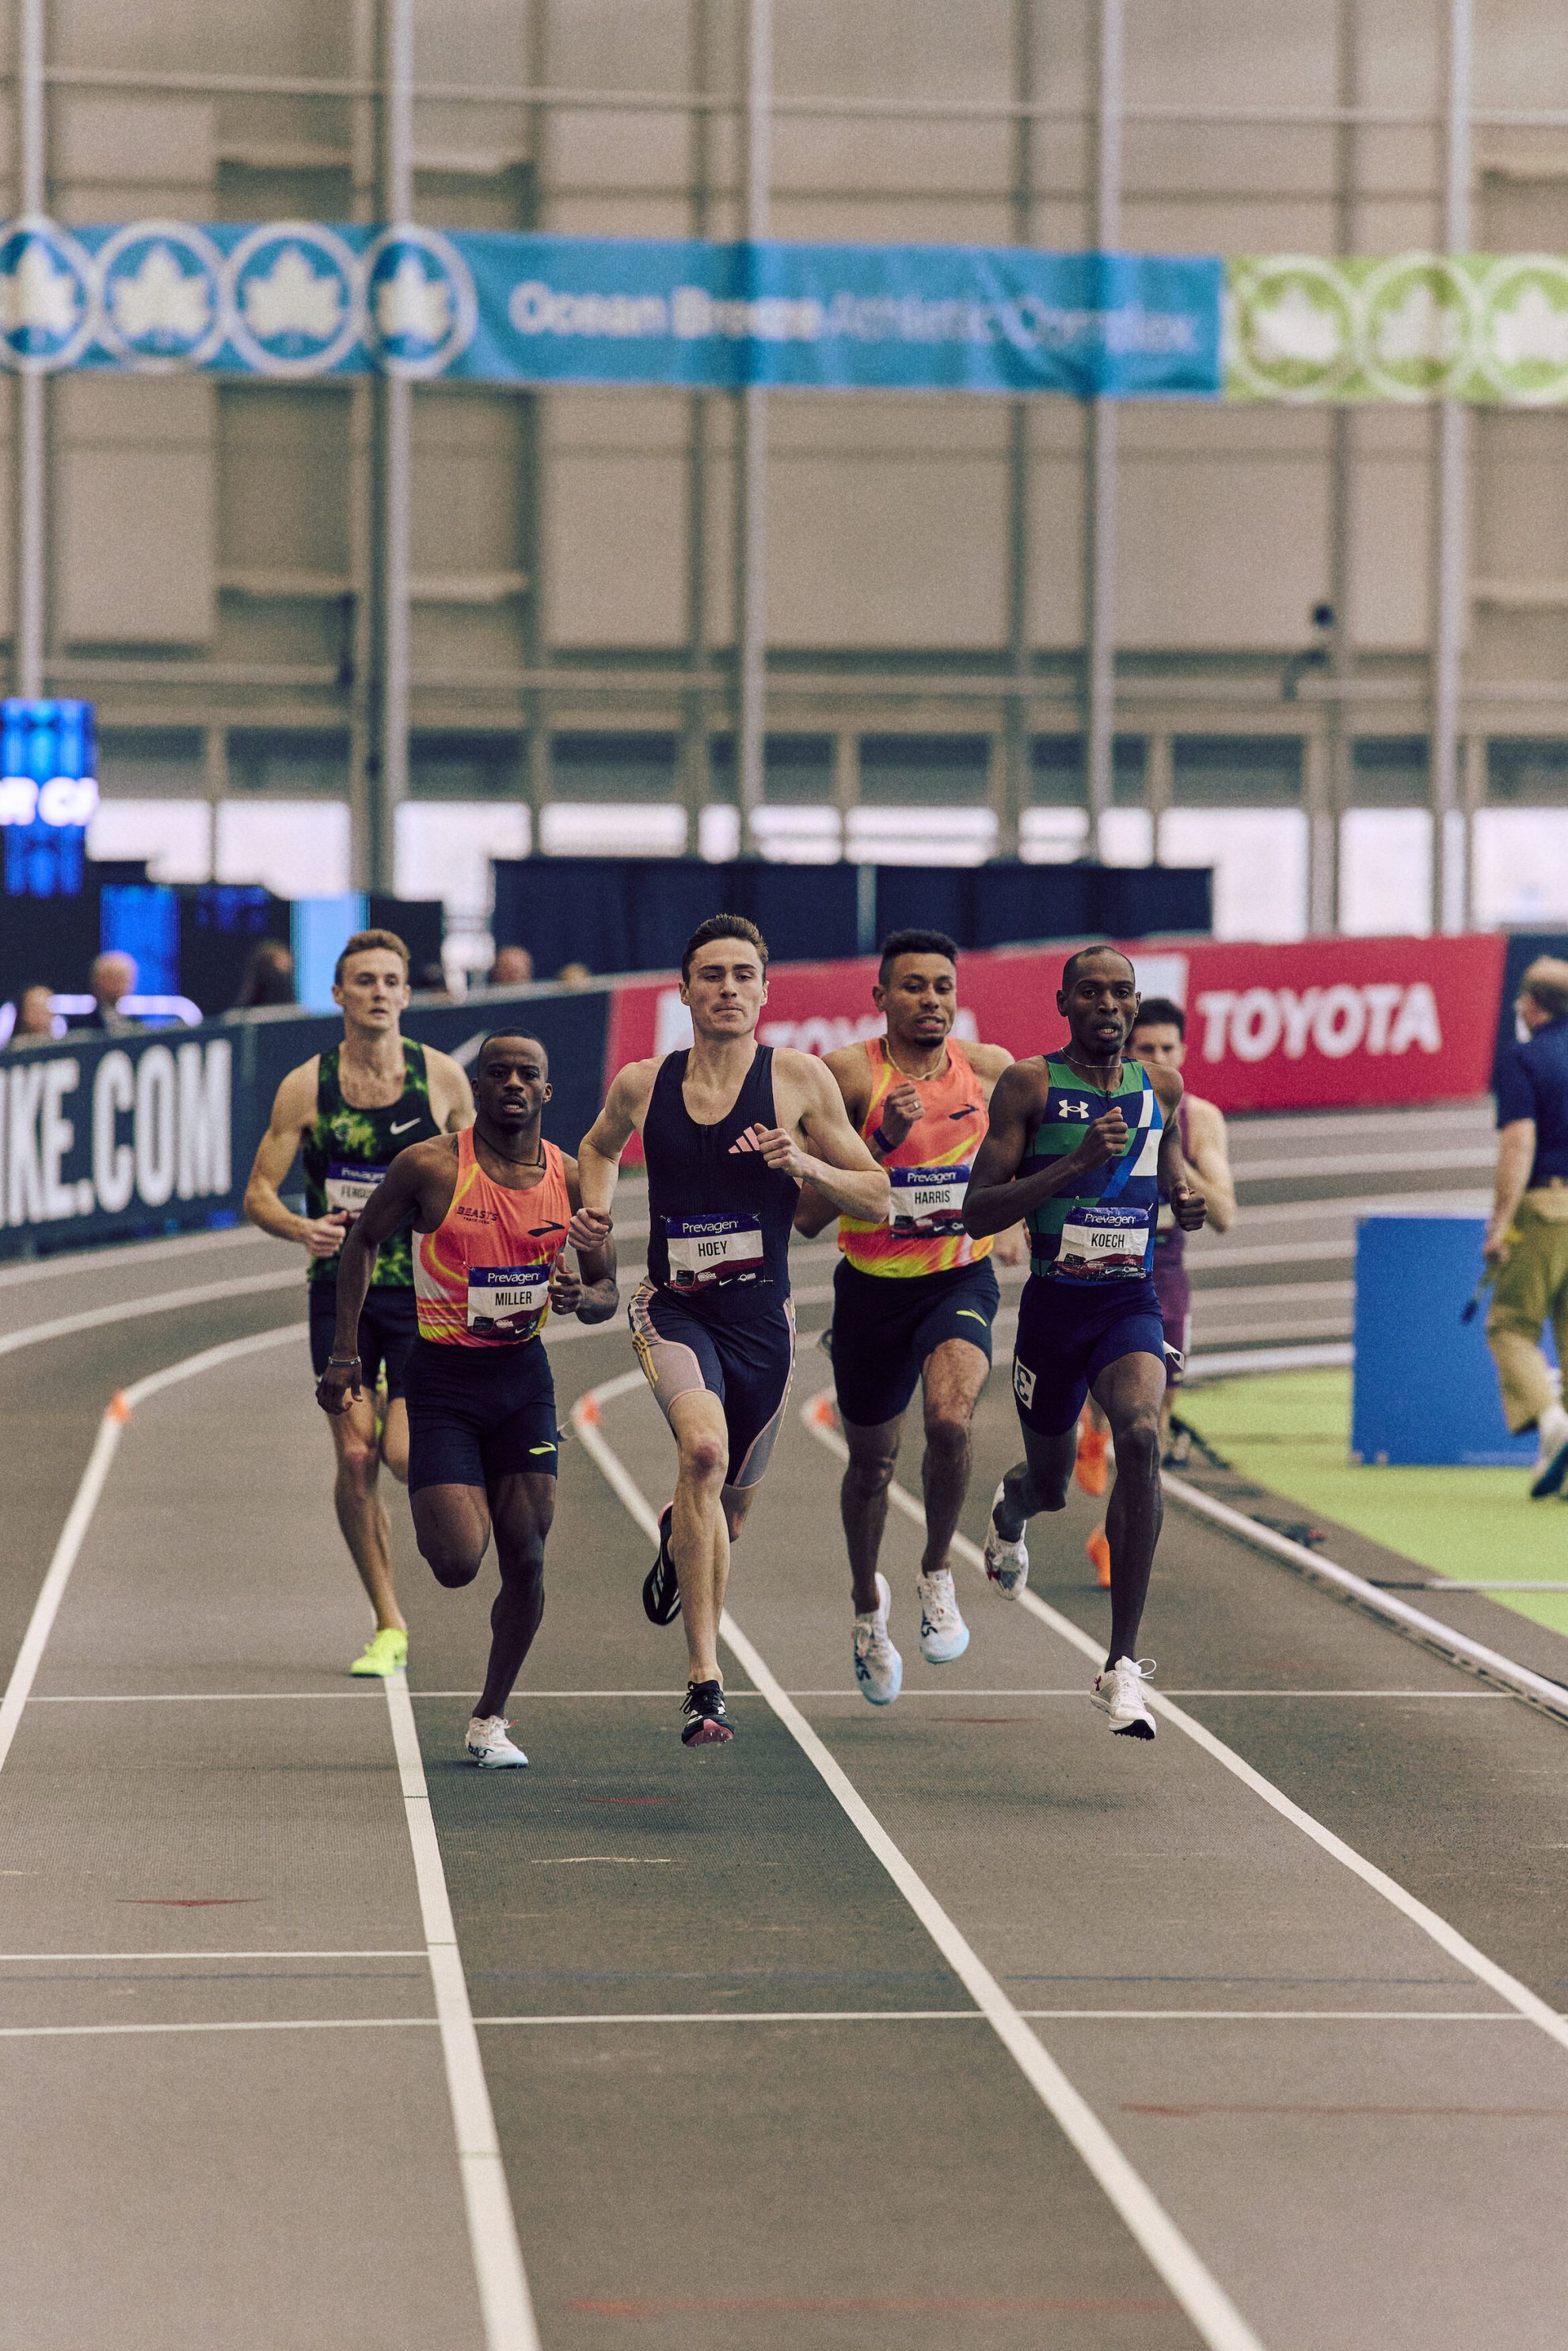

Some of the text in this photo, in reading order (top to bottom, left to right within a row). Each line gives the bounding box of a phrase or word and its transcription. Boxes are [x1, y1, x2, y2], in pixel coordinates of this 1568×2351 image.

[1197, 982, 1443, 1064] TOYOTA
[907, 1172, 957, 1183] Prevagen
[915, 1190, 950, 1204] HARRIS
[457, 1206, 499, 1221] BEASTS
[1084, 1214, 1136, 1226] Prevagen
[683, 1221, 738, 1233] Prevagen
[1091, 1233, 1125, 1248] KOECH
[698, 1240, 728, 1257] HOEY
[488, 1273, 539, 1284] Prevagen
[495, 1291, 532, 1305] MILLER
